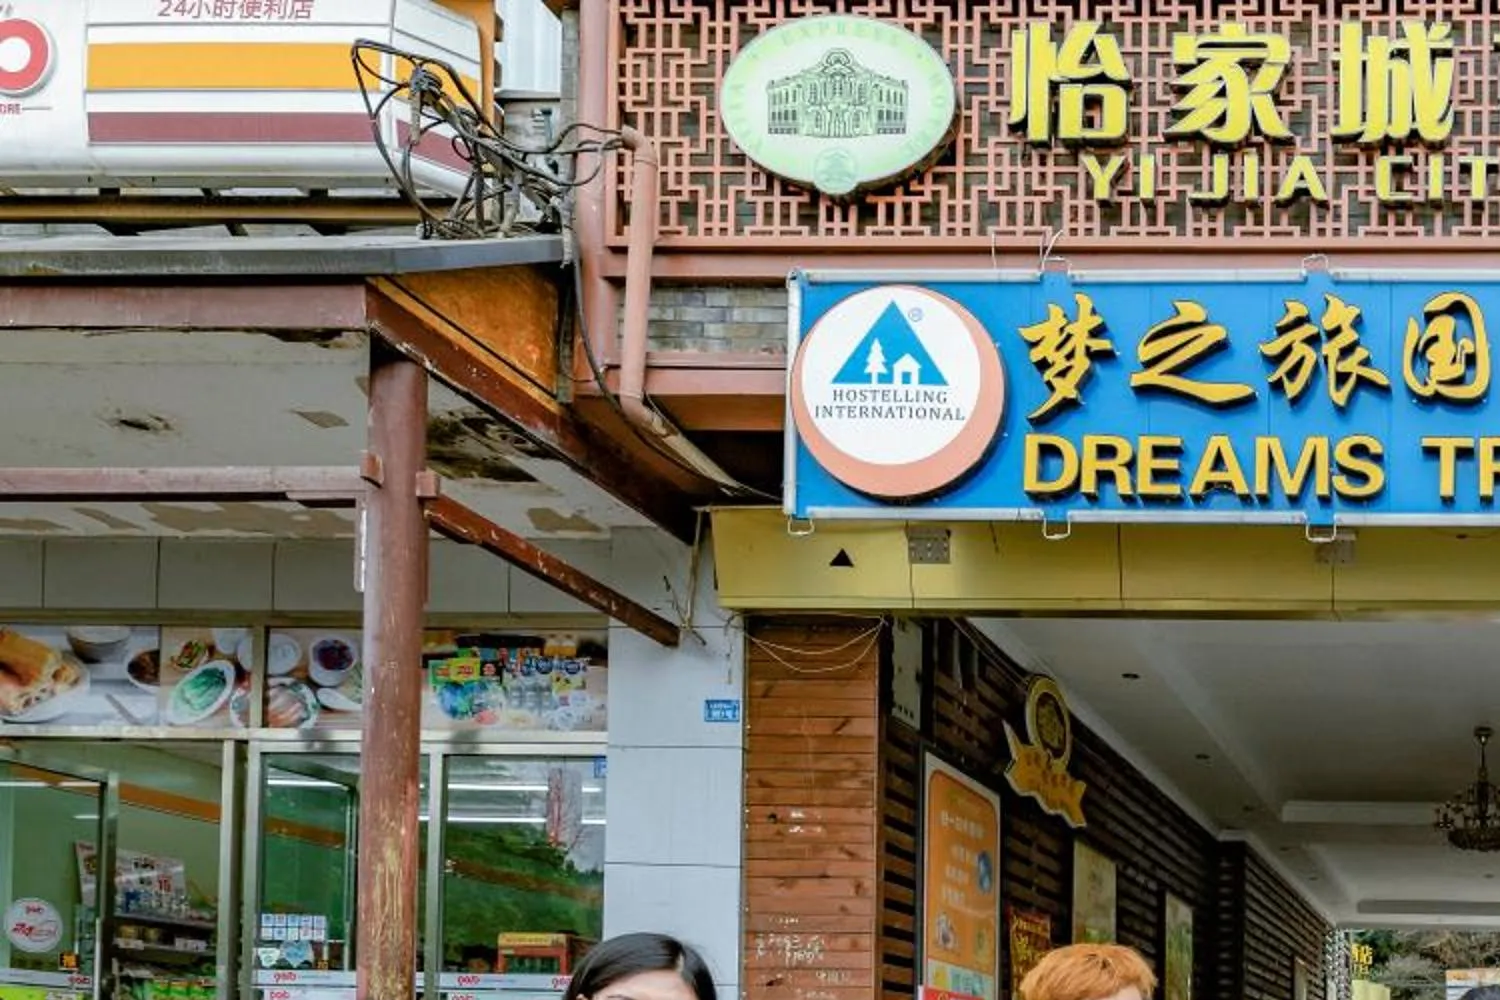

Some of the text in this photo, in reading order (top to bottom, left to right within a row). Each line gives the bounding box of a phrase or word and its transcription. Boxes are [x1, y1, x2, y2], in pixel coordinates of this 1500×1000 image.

[1080, 153, 1157, 205] YI
[1188, 150, 1330, 206] JIA
[814, 405, 966, 422] INTERNATIONAL
[832, 389, 948, 404] HOSTELLING
[1023, 433, 1387, 501] DREAMS
